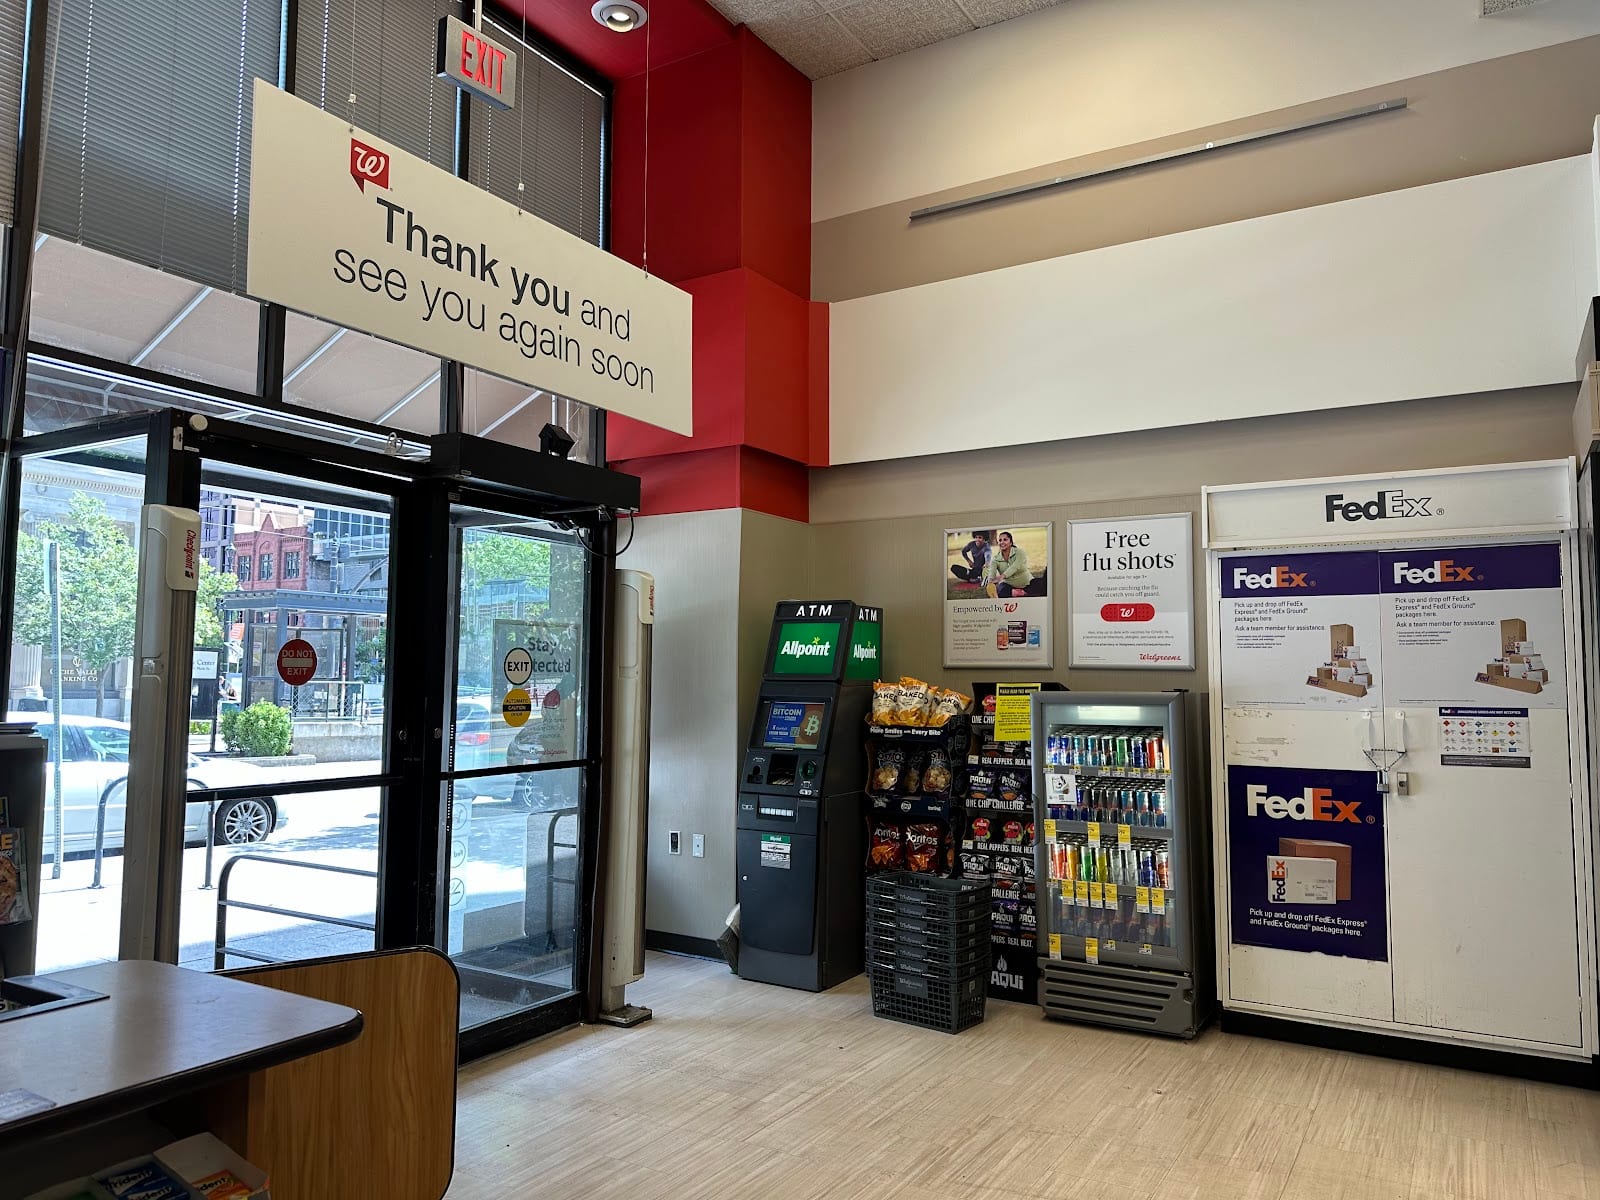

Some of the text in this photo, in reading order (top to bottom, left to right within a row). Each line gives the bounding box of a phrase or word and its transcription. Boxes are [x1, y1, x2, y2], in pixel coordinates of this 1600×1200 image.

[460, 30, 506, 94] EXIT
[376, 196, 630, 342] Thank you and
[334, 249, 654, 394] see you again soon
[1105, 532, 1150, 548] Free
[184, 530, 196, 570] Checkpoint
[1082, 552, 1112, 572] flu
[796, 604, 832, 616] ATM
[859, 608, 877, 621] ATM
[953, 605, 993, 614] Empowered
[995, 604, 1002, 614] by
[528, 637, 556, 656] Stay
[780, 640, 830, 658] Allpoint
[853, 644, 876, 661] Allpoint
[532, 658, 571, 673] tected
[1139, 653, 1182, 663] Walgreens
[508, 662, 529, 671] EXIT
[898, 690, 925, 700] BAKED
[966, 798, 1024, 810] ONE CHIP CHALLENGE
[905, 832, 938, 845] Doritos
[1272, 861, 1285, 902] FedEx
[1250, 908, 1263, 916] Pick
[1288, 913, 1302, 921] drop
[1315, 915, 1335, 924] FedEx
[1263, 919, 1283, 927] FedEx
[1312, 925, 1343, 934] packages
[1345, 928, 1362, 936] here.
[1008, 937, 1019, 946] REAL
[106, 1170, 152, 1190] Trident
